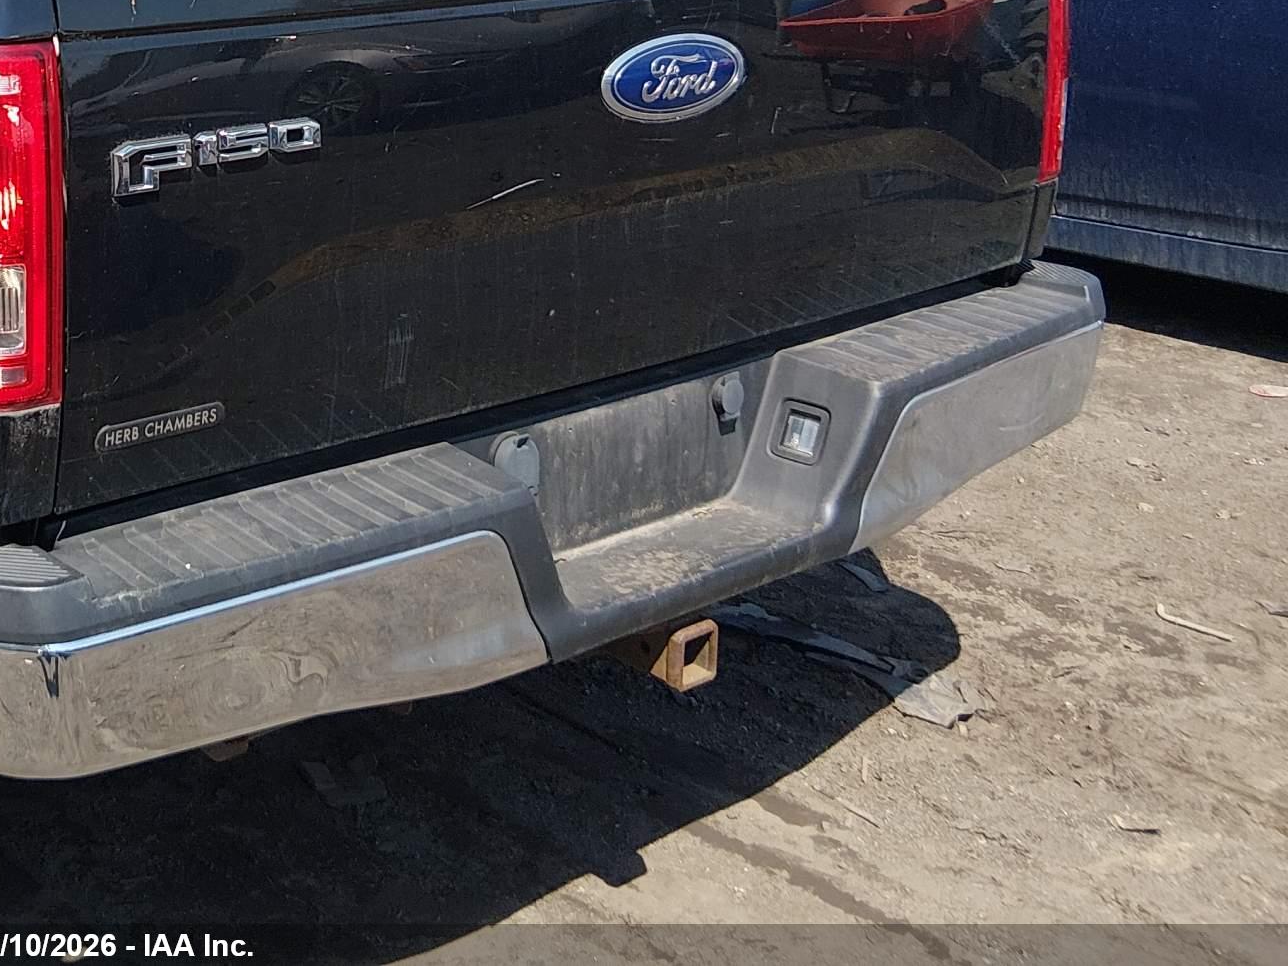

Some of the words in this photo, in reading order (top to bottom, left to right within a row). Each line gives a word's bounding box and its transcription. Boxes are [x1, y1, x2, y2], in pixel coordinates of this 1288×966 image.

[642, 54, 718, 103] Ford
[105, 426, 139, 447] HERB
[144, 408, 217, 438] CHAMBERS
